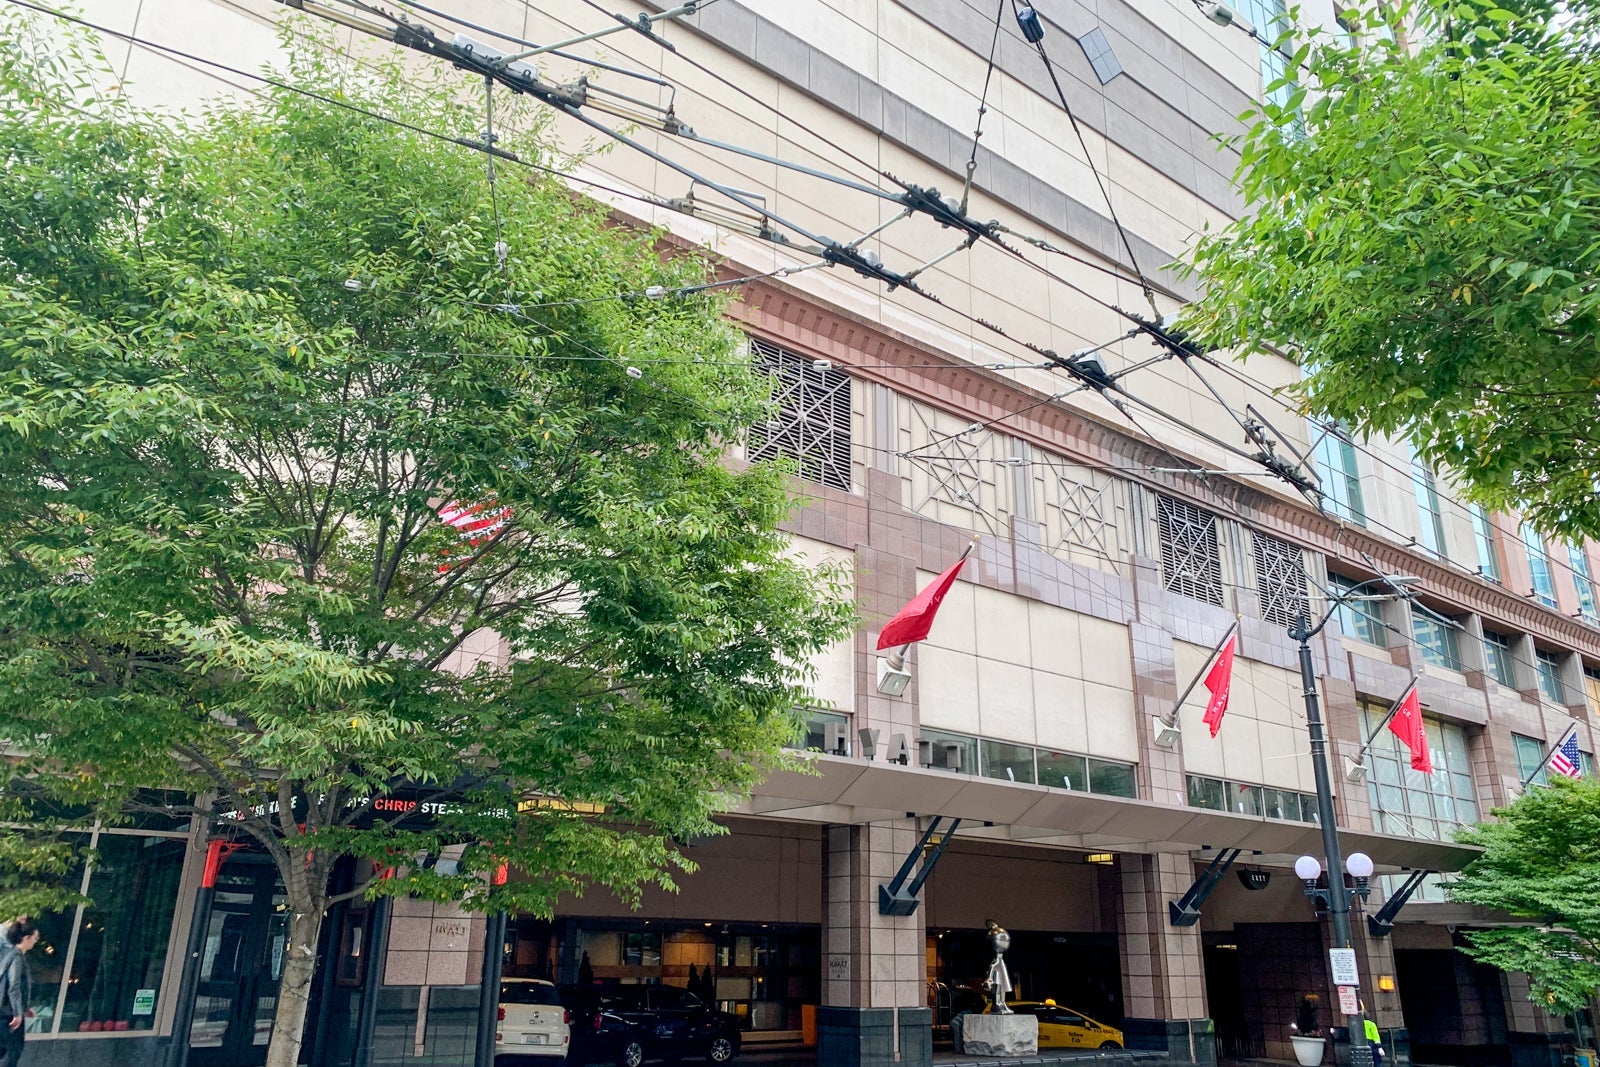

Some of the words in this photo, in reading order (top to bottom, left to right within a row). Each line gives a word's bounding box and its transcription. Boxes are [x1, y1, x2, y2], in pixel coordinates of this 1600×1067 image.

[824, 721, 966, 768] HYATT
[374, 798, 417, 812] CHRIS
[1251, 874, 1266, 882] EXIT
